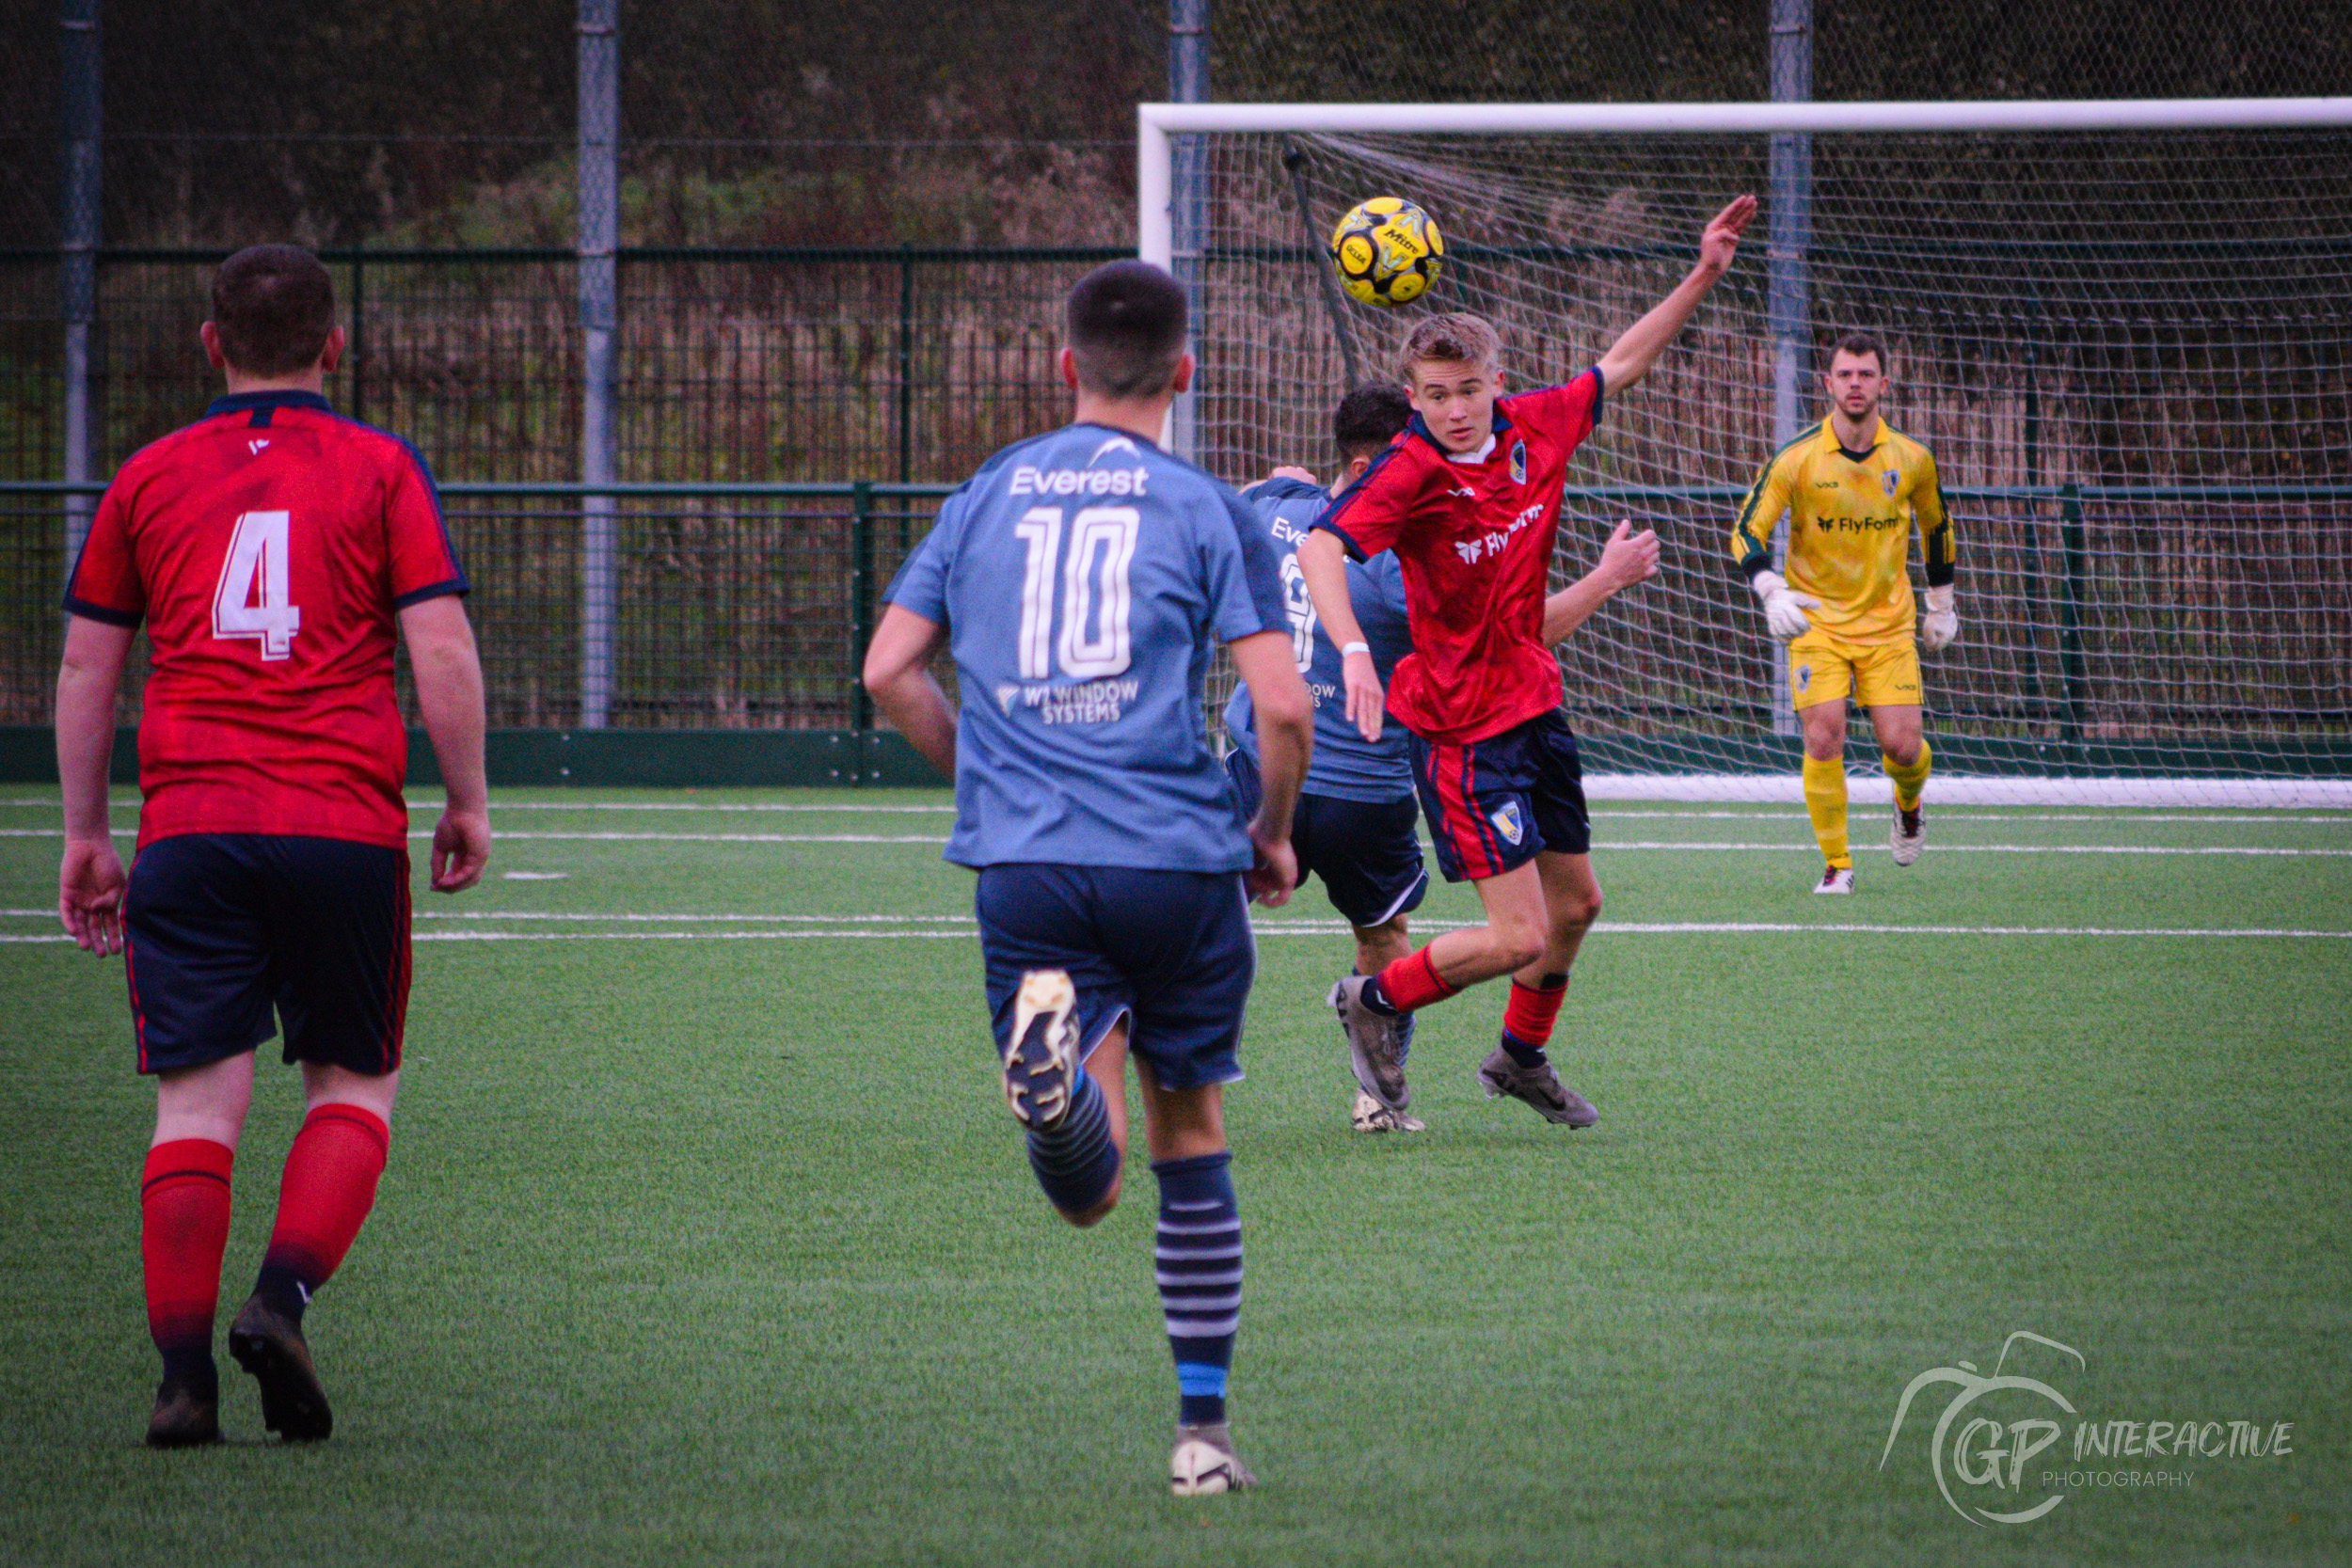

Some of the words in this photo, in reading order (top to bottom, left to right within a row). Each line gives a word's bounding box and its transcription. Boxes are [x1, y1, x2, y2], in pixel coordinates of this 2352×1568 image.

[1346, 245, 1367, 264] DELTA
[1009, 466, 1149, 497] Everest
[1839, 516, 1899, 534] FlyForm
[212, 510, 300, 661] 4
[1015, 507, 1140, 679] 10
[1279, 553, 1318, 673] 9
[1053, 680, 1138, 704] WINDOW
[1042, 703, 1120, 725] SYSTEMS
